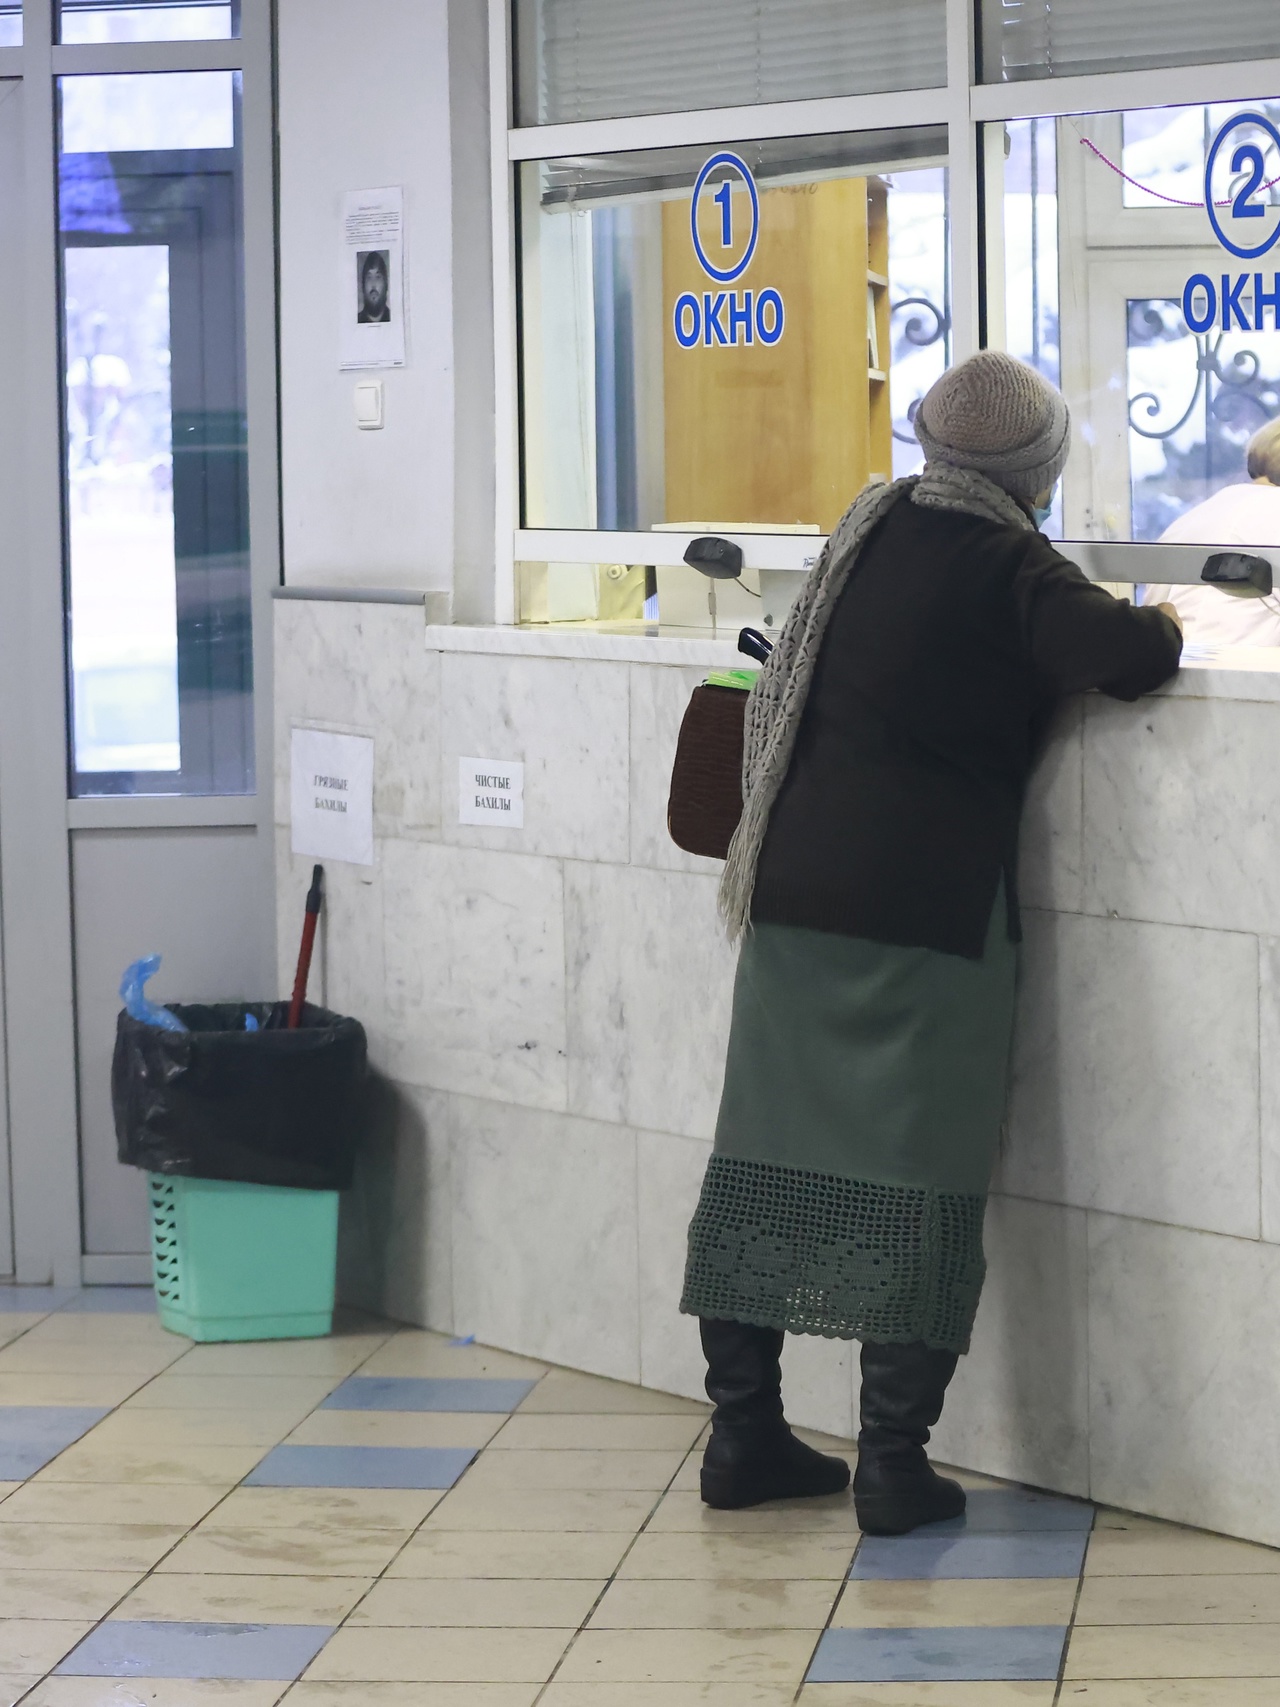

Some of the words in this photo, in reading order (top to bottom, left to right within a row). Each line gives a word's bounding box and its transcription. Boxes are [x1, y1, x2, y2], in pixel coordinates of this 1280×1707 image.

[1231, 144, 1266, 218] 2
[714, 182, 732, 246] 1
[674, 288, 784, 348] ОКНО
[475, 774, 511, 790] ЧИСТЫЕ
[314, 797, 348, 813] БАХИЛЫ
[475, 795, 511, 811] БАХИЛЫ
